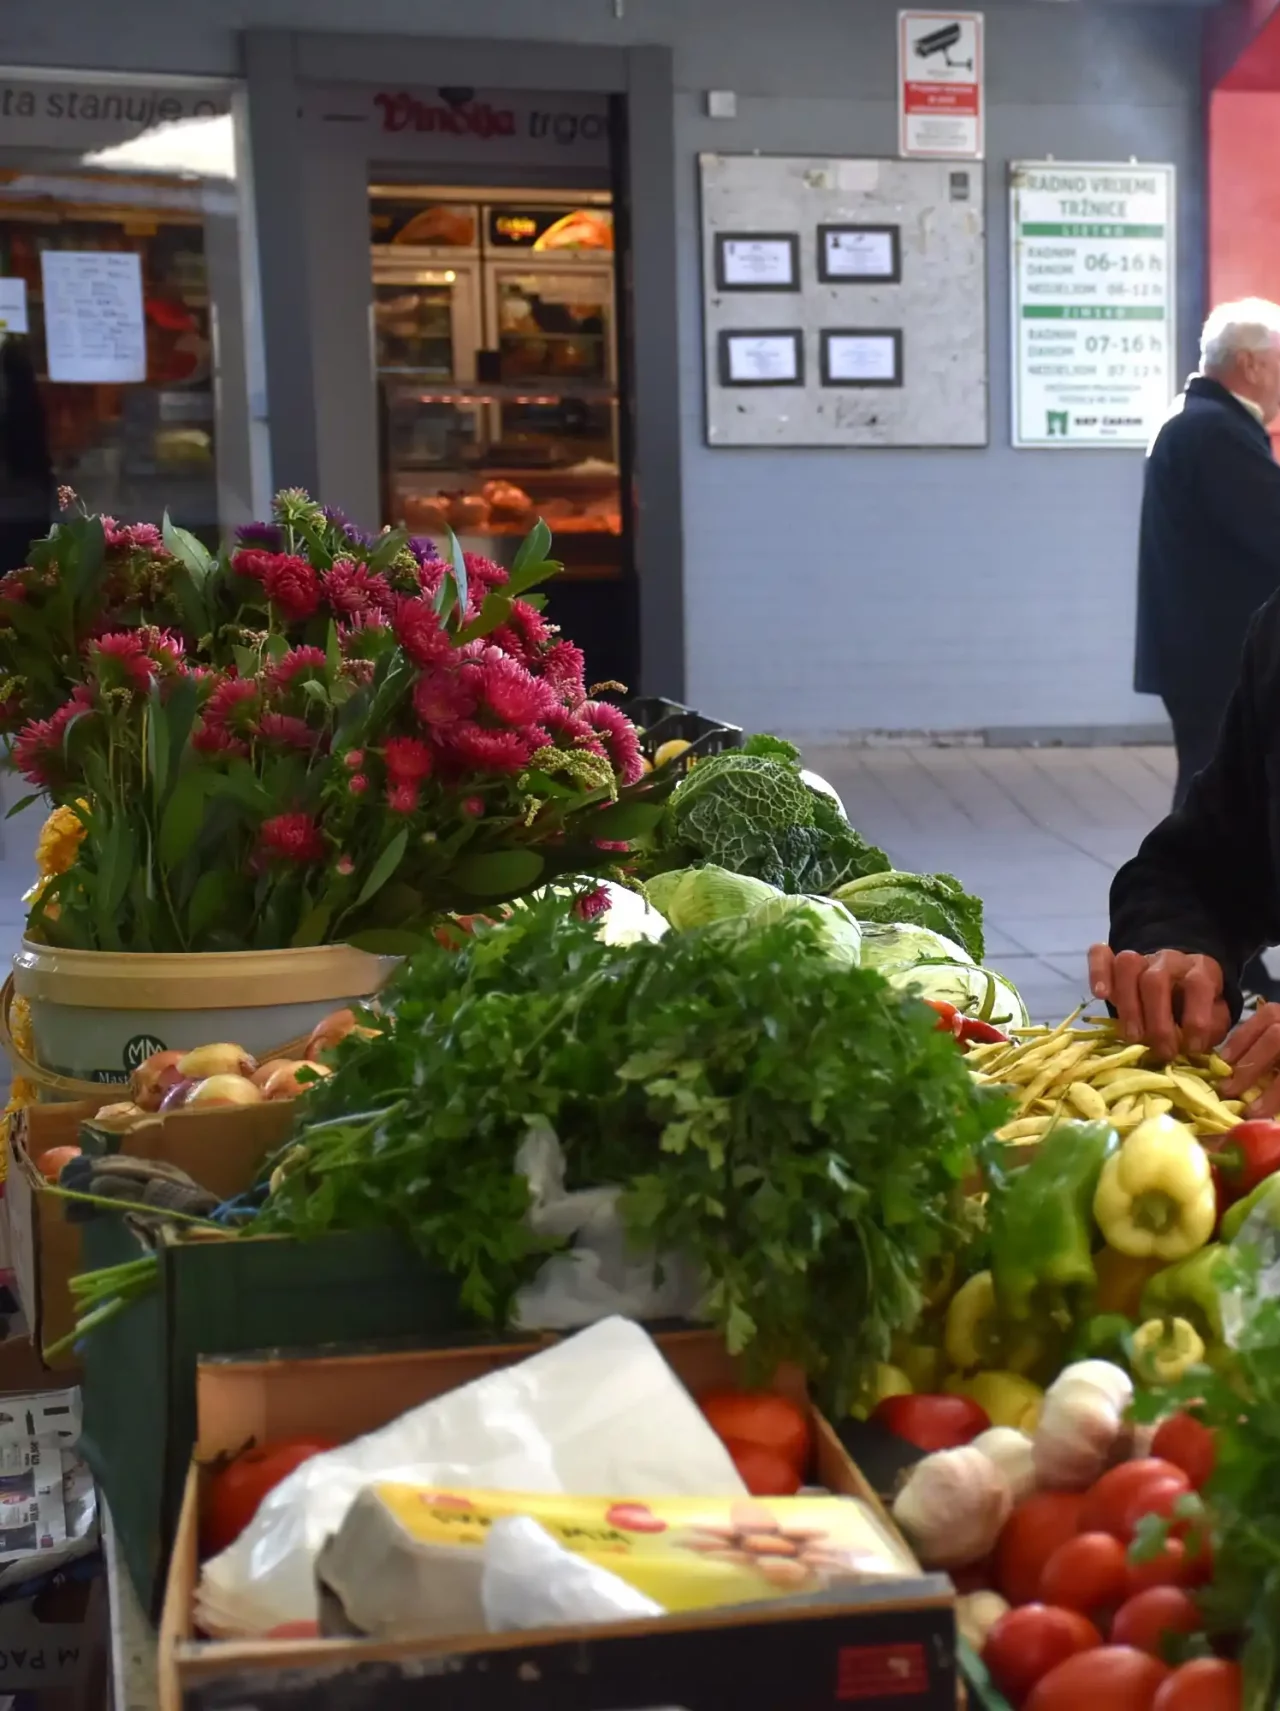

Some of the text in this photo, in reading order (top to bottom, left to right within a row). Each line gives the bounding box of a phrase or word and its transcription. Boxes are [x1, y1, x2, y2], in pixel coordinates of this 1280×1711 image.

[46, 91, 183, 128] stanuje
[1026, 175, 1156, 194] RADNO VRIJEME
[1059, 199, 1127, 217] TRŽNICE
[1084, 254, 1145, 272] 06-16
[1149, 253, 1163, 272] h
[1085, 336, 1145, 354] 07-16
[1150, 335, 1163, 353] h
